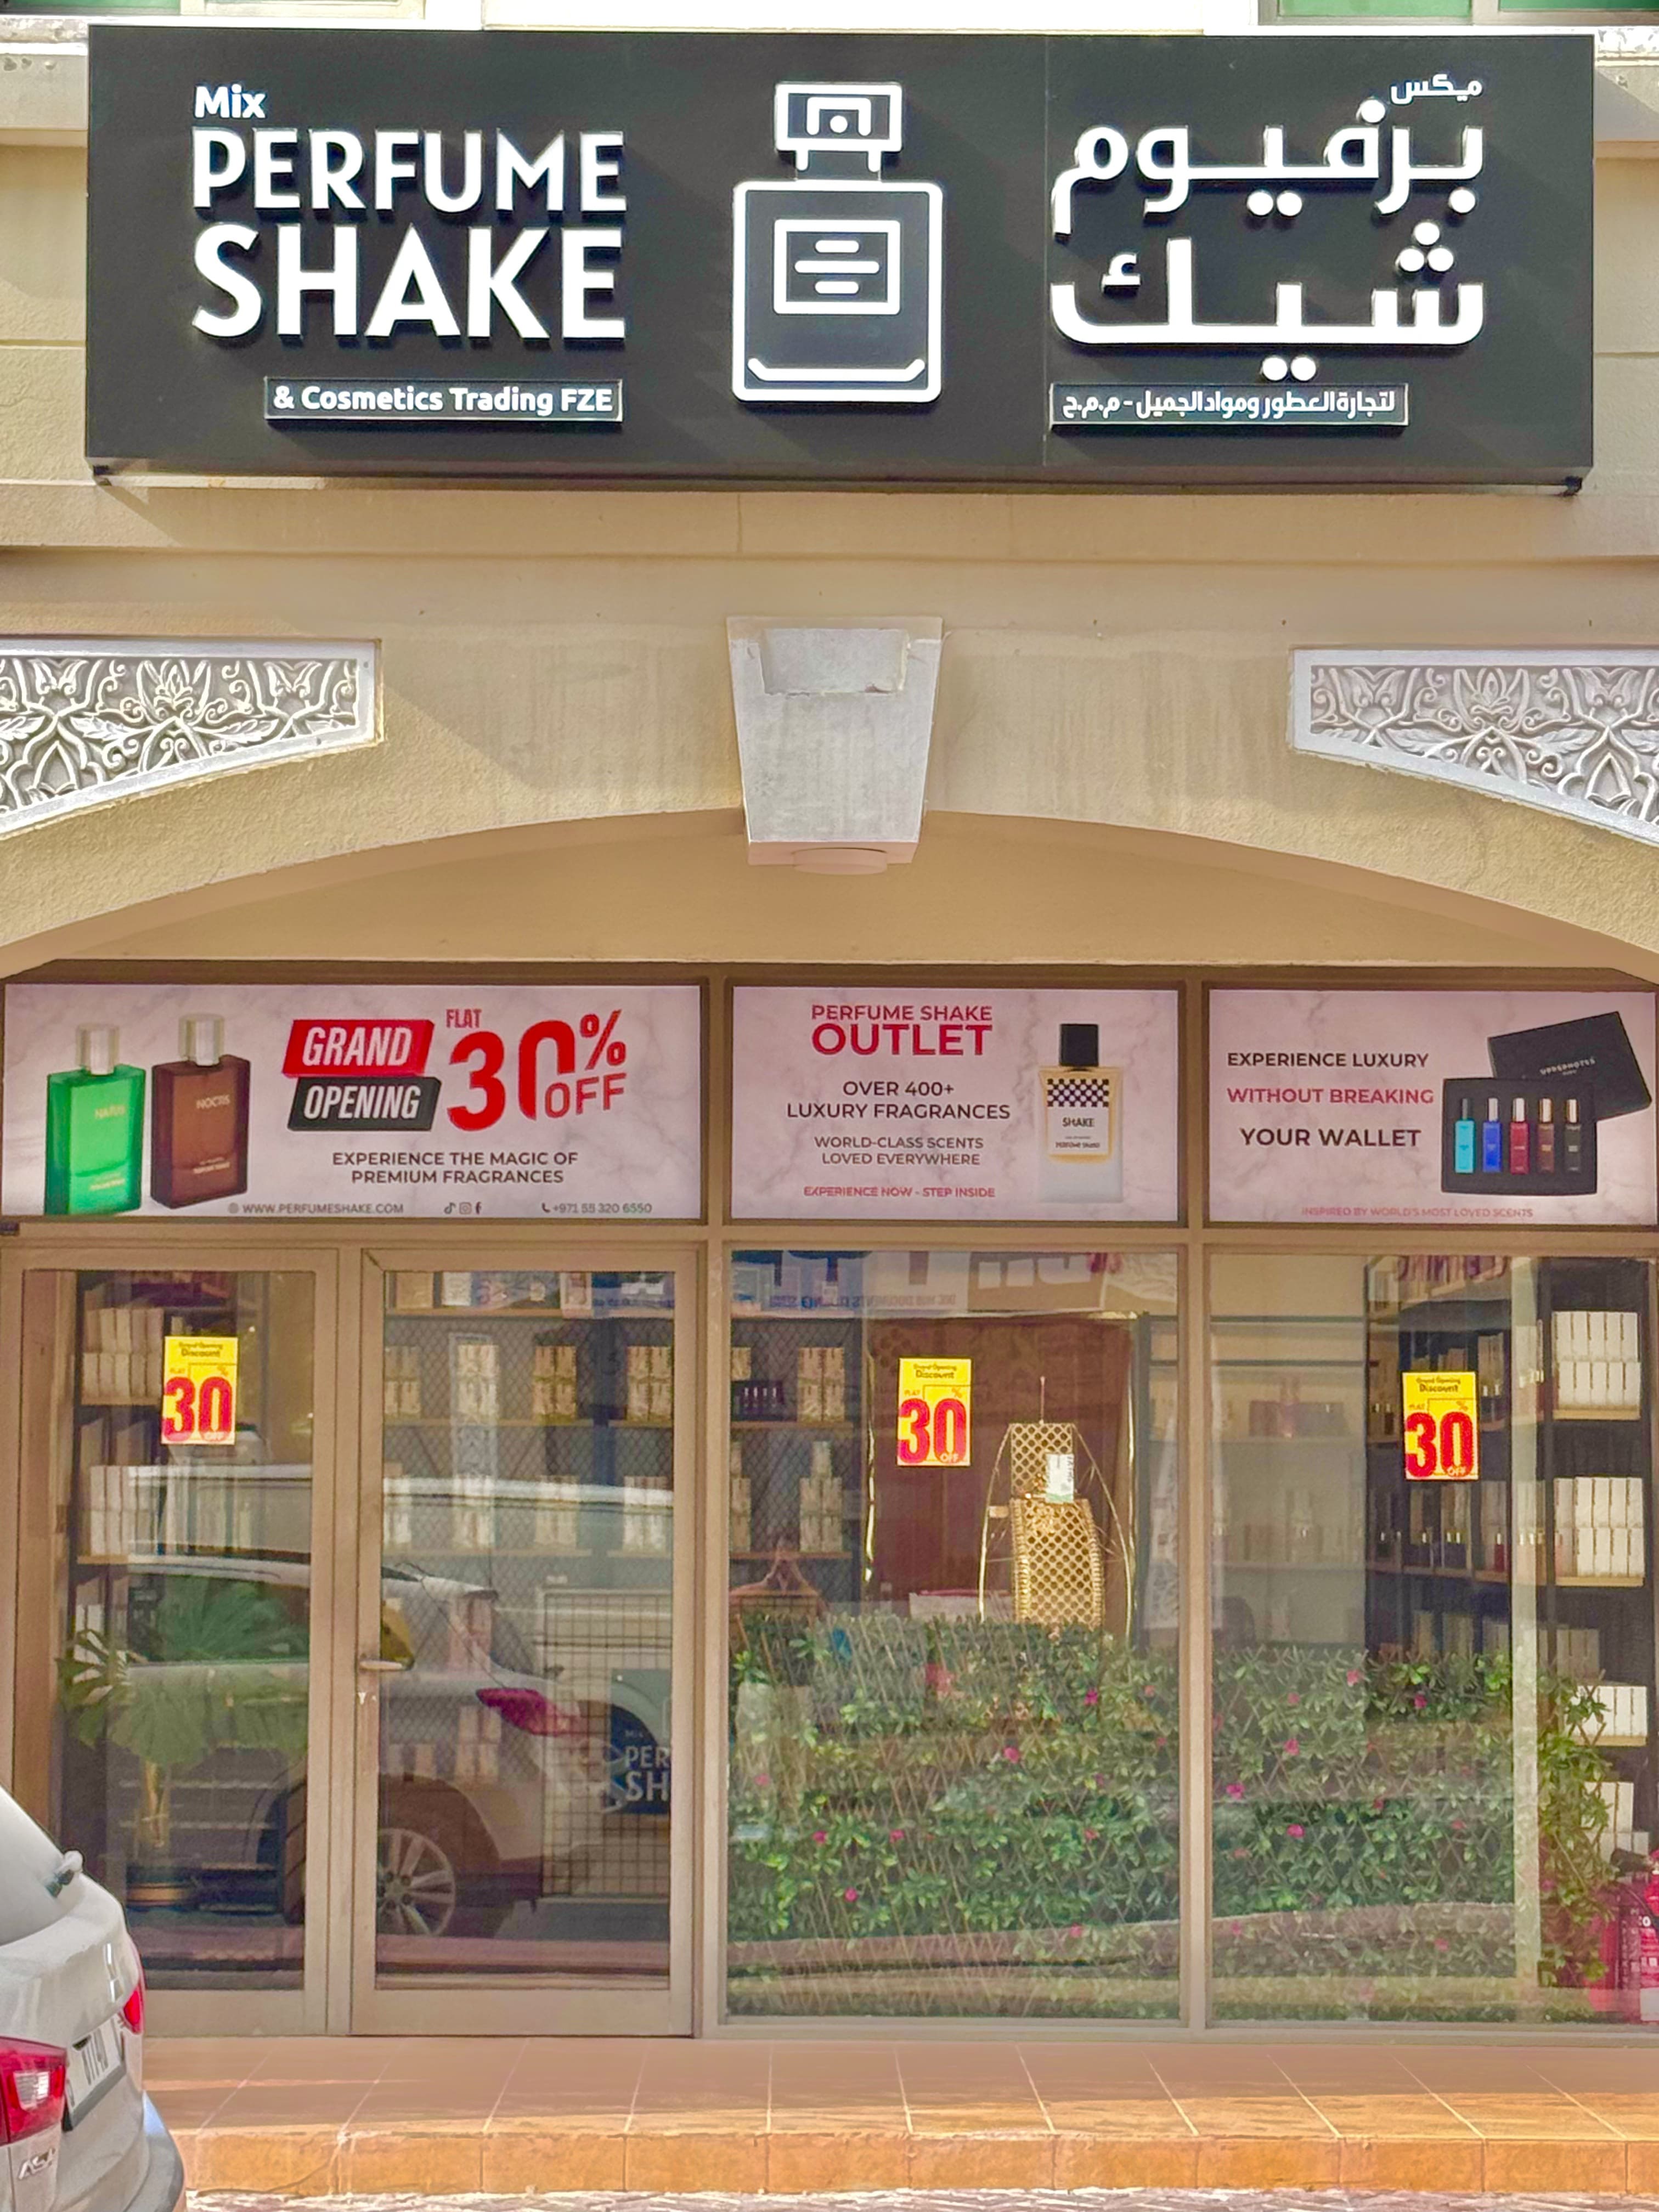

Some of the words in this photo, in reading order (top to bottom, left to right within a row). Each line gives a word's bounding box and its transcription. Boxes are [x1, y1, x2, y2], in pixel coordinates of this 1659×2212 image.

[1391, 73, 1483, 104] ميكس
[194, 84, 266, 119] Mix
[192, 127, 627, 212] PERFUME
[1052, 99, 1483, 235] برفيوم
[192, 222, 626, 338] SHAKE
[1050, 221, 1483, 381] شيك
[274, 386, 294, 409] &
[302, 386, 443, 410] Cosmetics
[449, 386, 552, 416] Trading
[561, 388, 613, 411] FZE
[1262, 391, 1335, 419] العطور
[1336, 391, 1395, 419] لتجارة
[447, 1009, 482, 1028] FLAT
[811, 1005, 913, 1020] PERFUME
[920, 1006, 992, 1021] SHAKE
[302, 1027, 414, 1066] GRAND
[811, 1023, 992, 1056] OUTLET
[1227, 1052, 1346, 1068] EXPERIENCE
[1352, 1053, 1429, 1068] LUXURY
[545, 1073, 627, 1119] OFF
[843, 1081, 899, 1096] OVER
[905, 1082, 954, 1097] 400+
[1227, 1088, 1324, 1104] WITHOUT
[1329, 1088, 1434, 1105] BREAKING
[304, 1085, 422, 1120] OPENING
[787, 1103, 868, 1118] LUXURY
[874, 1104, 1011, 1119] FRAGRANCES
[815, 1136, 923, 1149] WORLD-CLASS
[927, 1137, 983, 1149] SCENTS
[1240, 1128, 1311, 1147] YOUR
[1317, 1128, 1422, 1147] WALLET
[332, 1153, 445, 1166] EXPERIENCE
[450, 1153, 483, 1165] THE
[490, 1153, 548, 1166] MAGIC
[554, 1153, 578, 1165] OF
[822, 1153, 873, 1165] LOVED
[877, 1153, 980, 1166] EVERYWHERE
[352, 1170, 437, 1183] PREMIUM
[443, 1170, 564, 1183] FRAGRANCES
[804, 1187, 877, 1197] EXPERIENCE
[881, 1187, 911, 1198] NOW
[922, 1187, 951, 1198] STEP
[955, 1187, 995, 1198] INSIDE
[242, 1203, 404, 1214] WWW.PERFUMESHAKE.COM
[1302, 1207, 1352, 1216] INSPIRED
[1353, 1207, 1368, 1216] BY
[1422, 1208, 1453, 1217] MOST
[1454, 1208, 1491, 1217] LOVED
[1493, 1208, 1533, 1218] SCENTS
[916, 1370, 955, 1379] Discount
[1419, 1384, 1458, 1393] Discount
